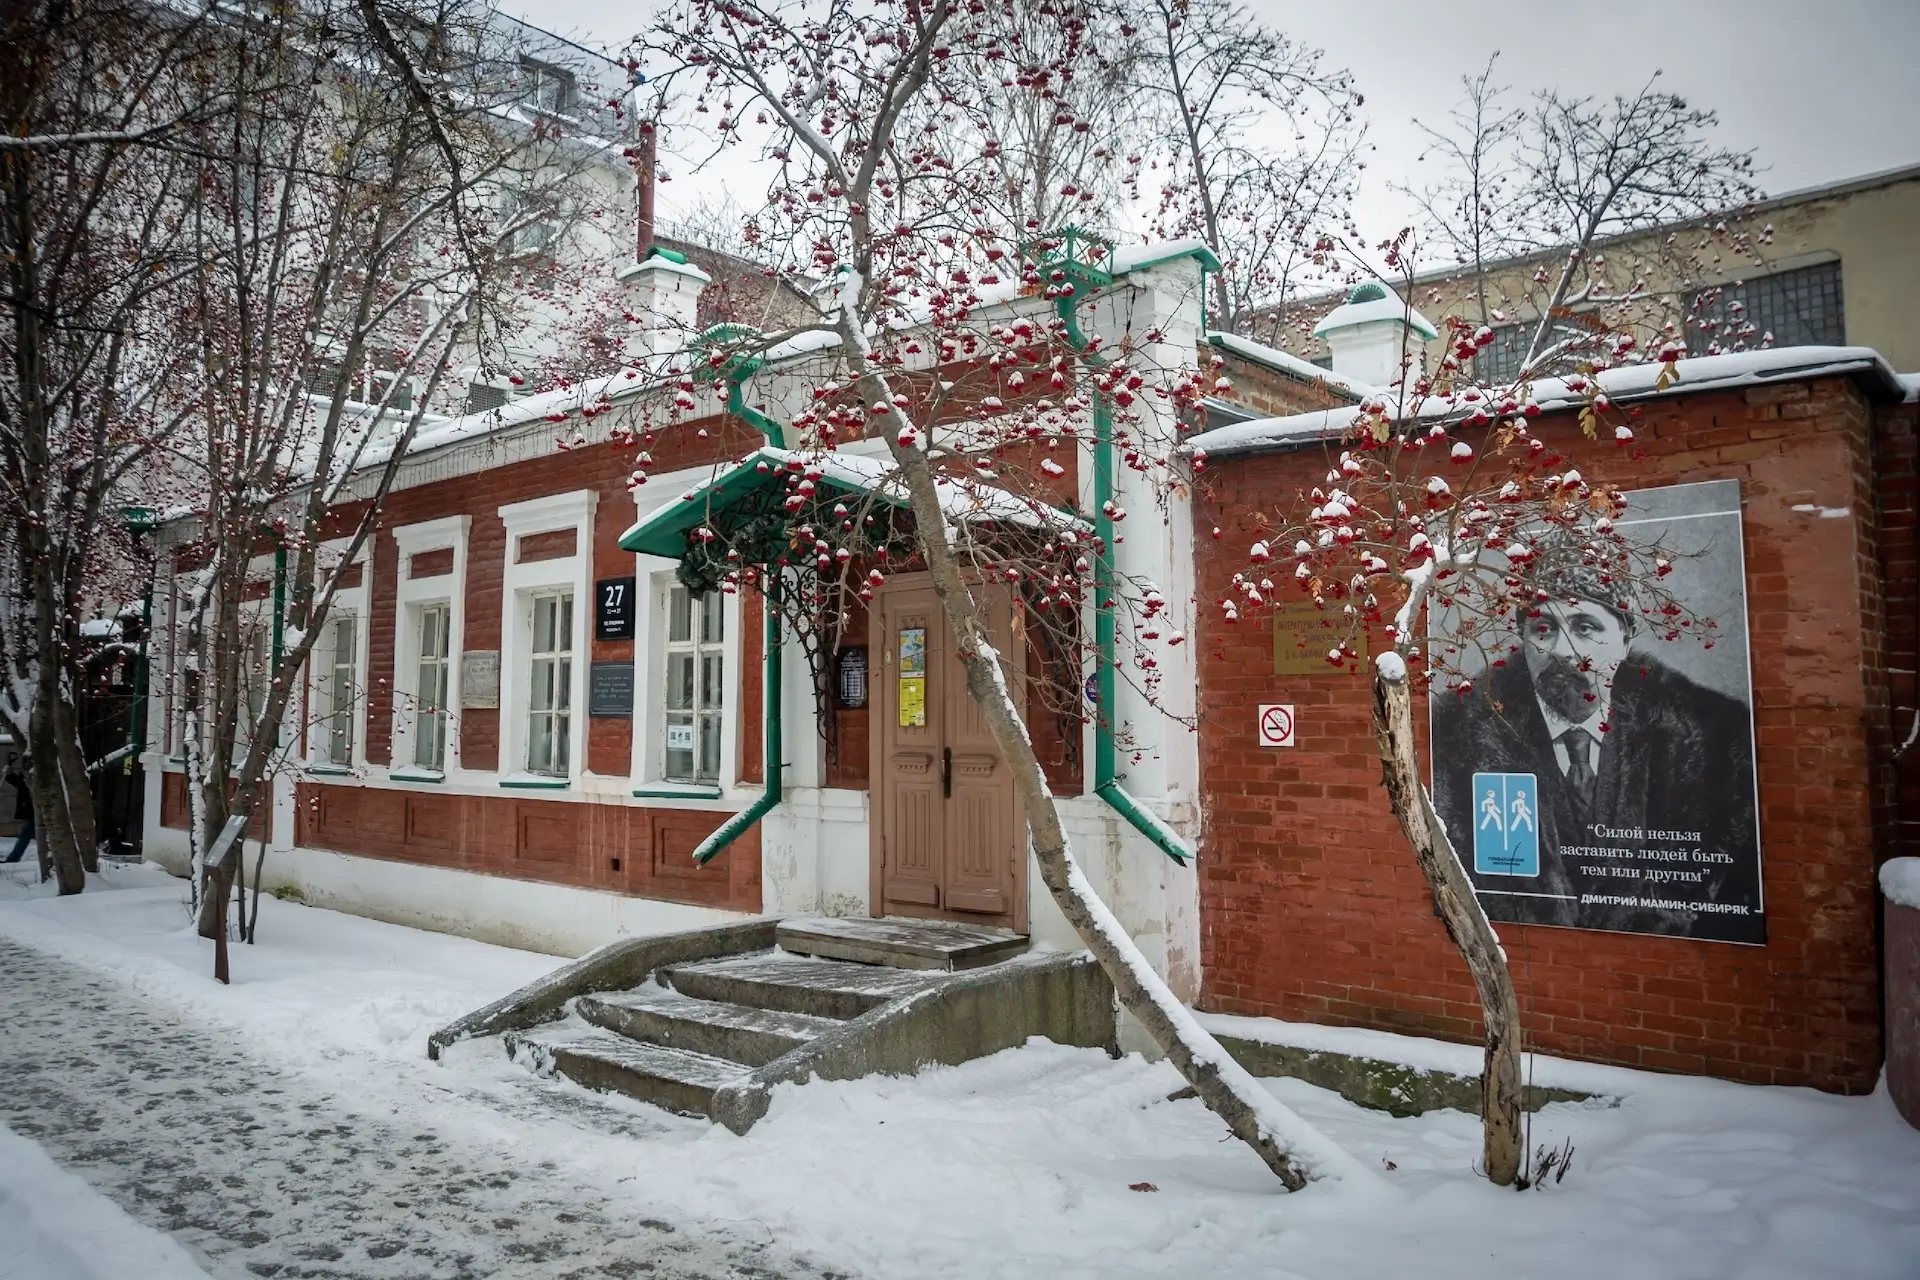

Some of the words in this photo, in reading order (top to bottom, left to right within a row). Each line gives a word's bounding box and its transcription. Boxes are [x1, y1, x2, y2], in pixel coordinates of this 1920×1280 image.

[605, 585, 624, 607] 27
[1647, 829, 1701, 842] нельзя
[1560, 845, 1634, 859] заставить
[1637, 848, 1687, 863] людей
[1692, 851, 1734, 864] быть
[1580, 865, 1607, 876] тем
[1611, 867, 1640, 879] или
[1580, 893, 1638, 908] ДМИТРИЙ
[1640, 898, 1750, 916] МАМИН-СИБИРЯК
